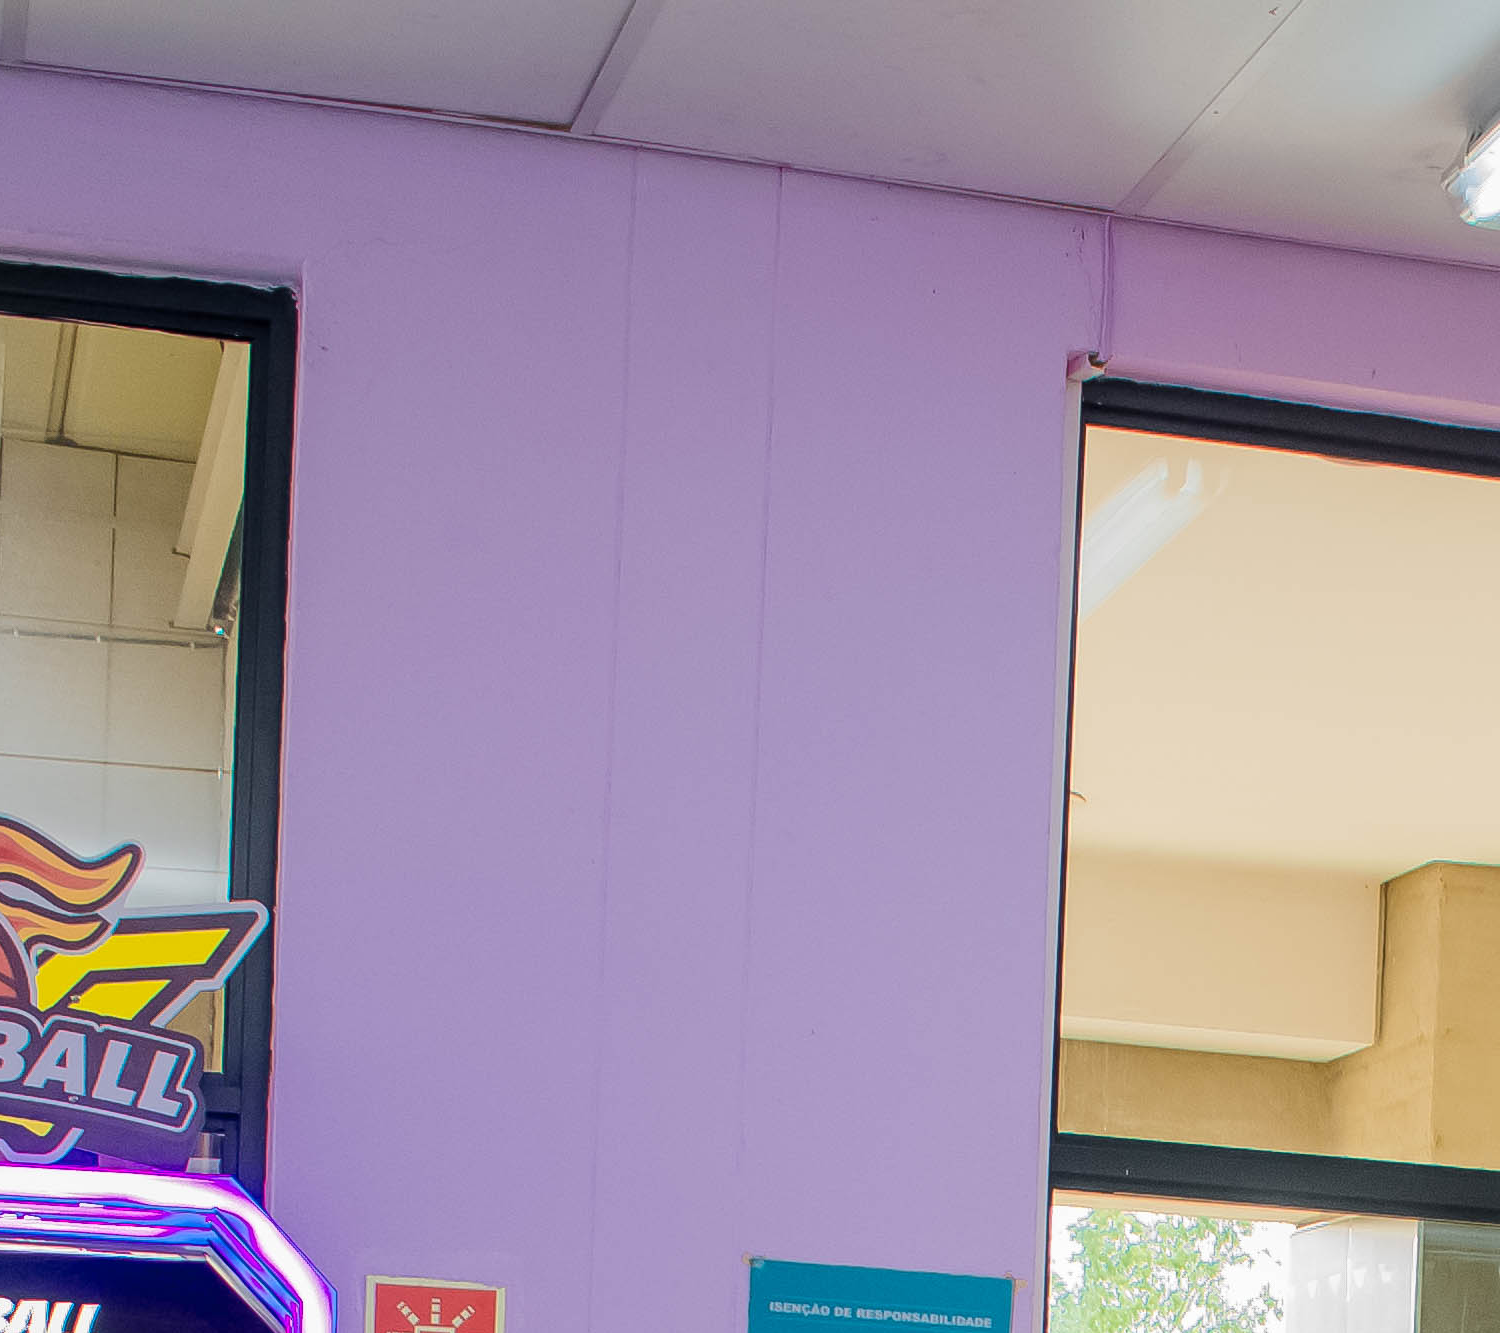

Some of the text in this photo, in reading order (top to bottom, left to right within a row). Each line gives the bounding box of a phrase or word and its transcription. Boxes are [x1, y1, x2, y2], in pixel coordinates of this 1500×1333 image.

[769, 1301, 992, 1329] ISENÇÃO DE RESPONSABILIDADE
